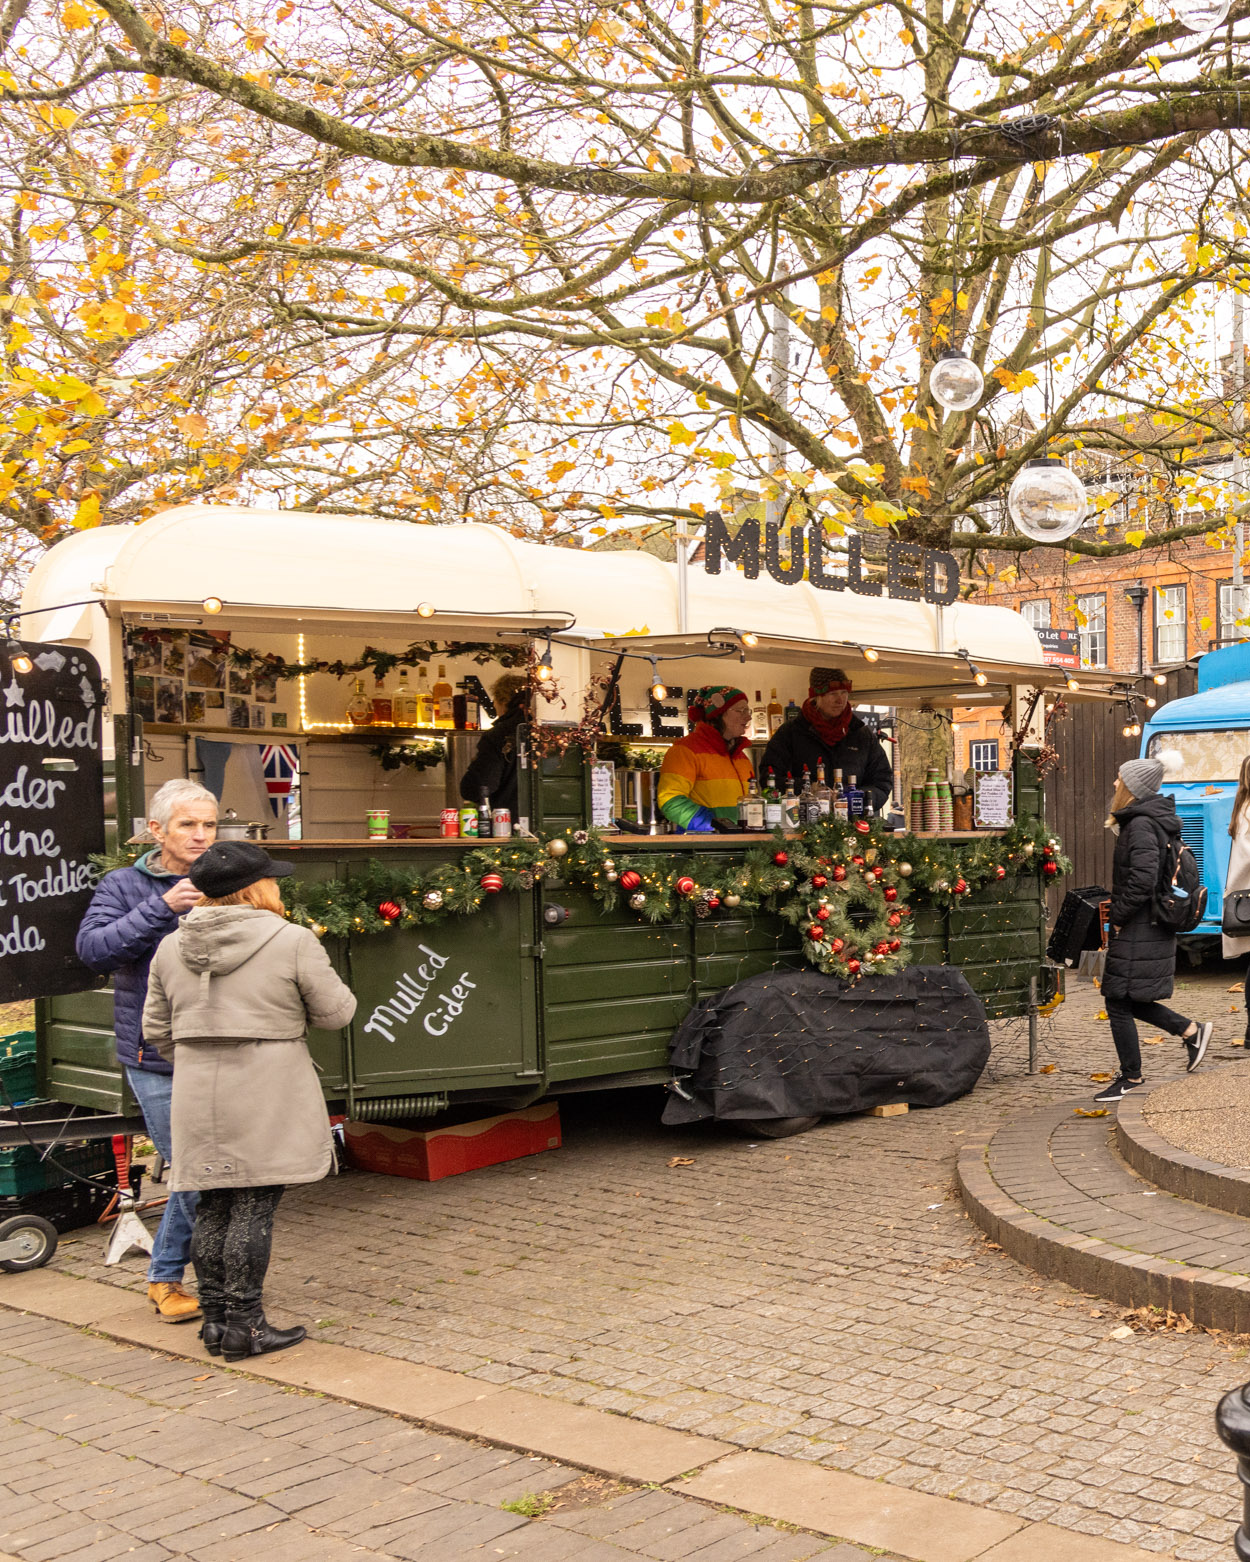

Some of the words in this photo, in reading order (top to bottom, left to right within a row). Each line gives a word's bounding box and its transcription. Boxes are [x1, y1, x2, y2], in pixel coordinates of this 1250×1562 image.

[703, 511, 960, 606] MULLED
[1046, 631, 1059, 640] Let
[0, 700, 98, 750] ulled
[0, 765, 66, 810] der
[0, 820, 61, 858] ine
[8, 858, 101, 904] Toddies
[364, 943, 450, 1043] Mulled
[423, 971, 477, 1036] Cider
